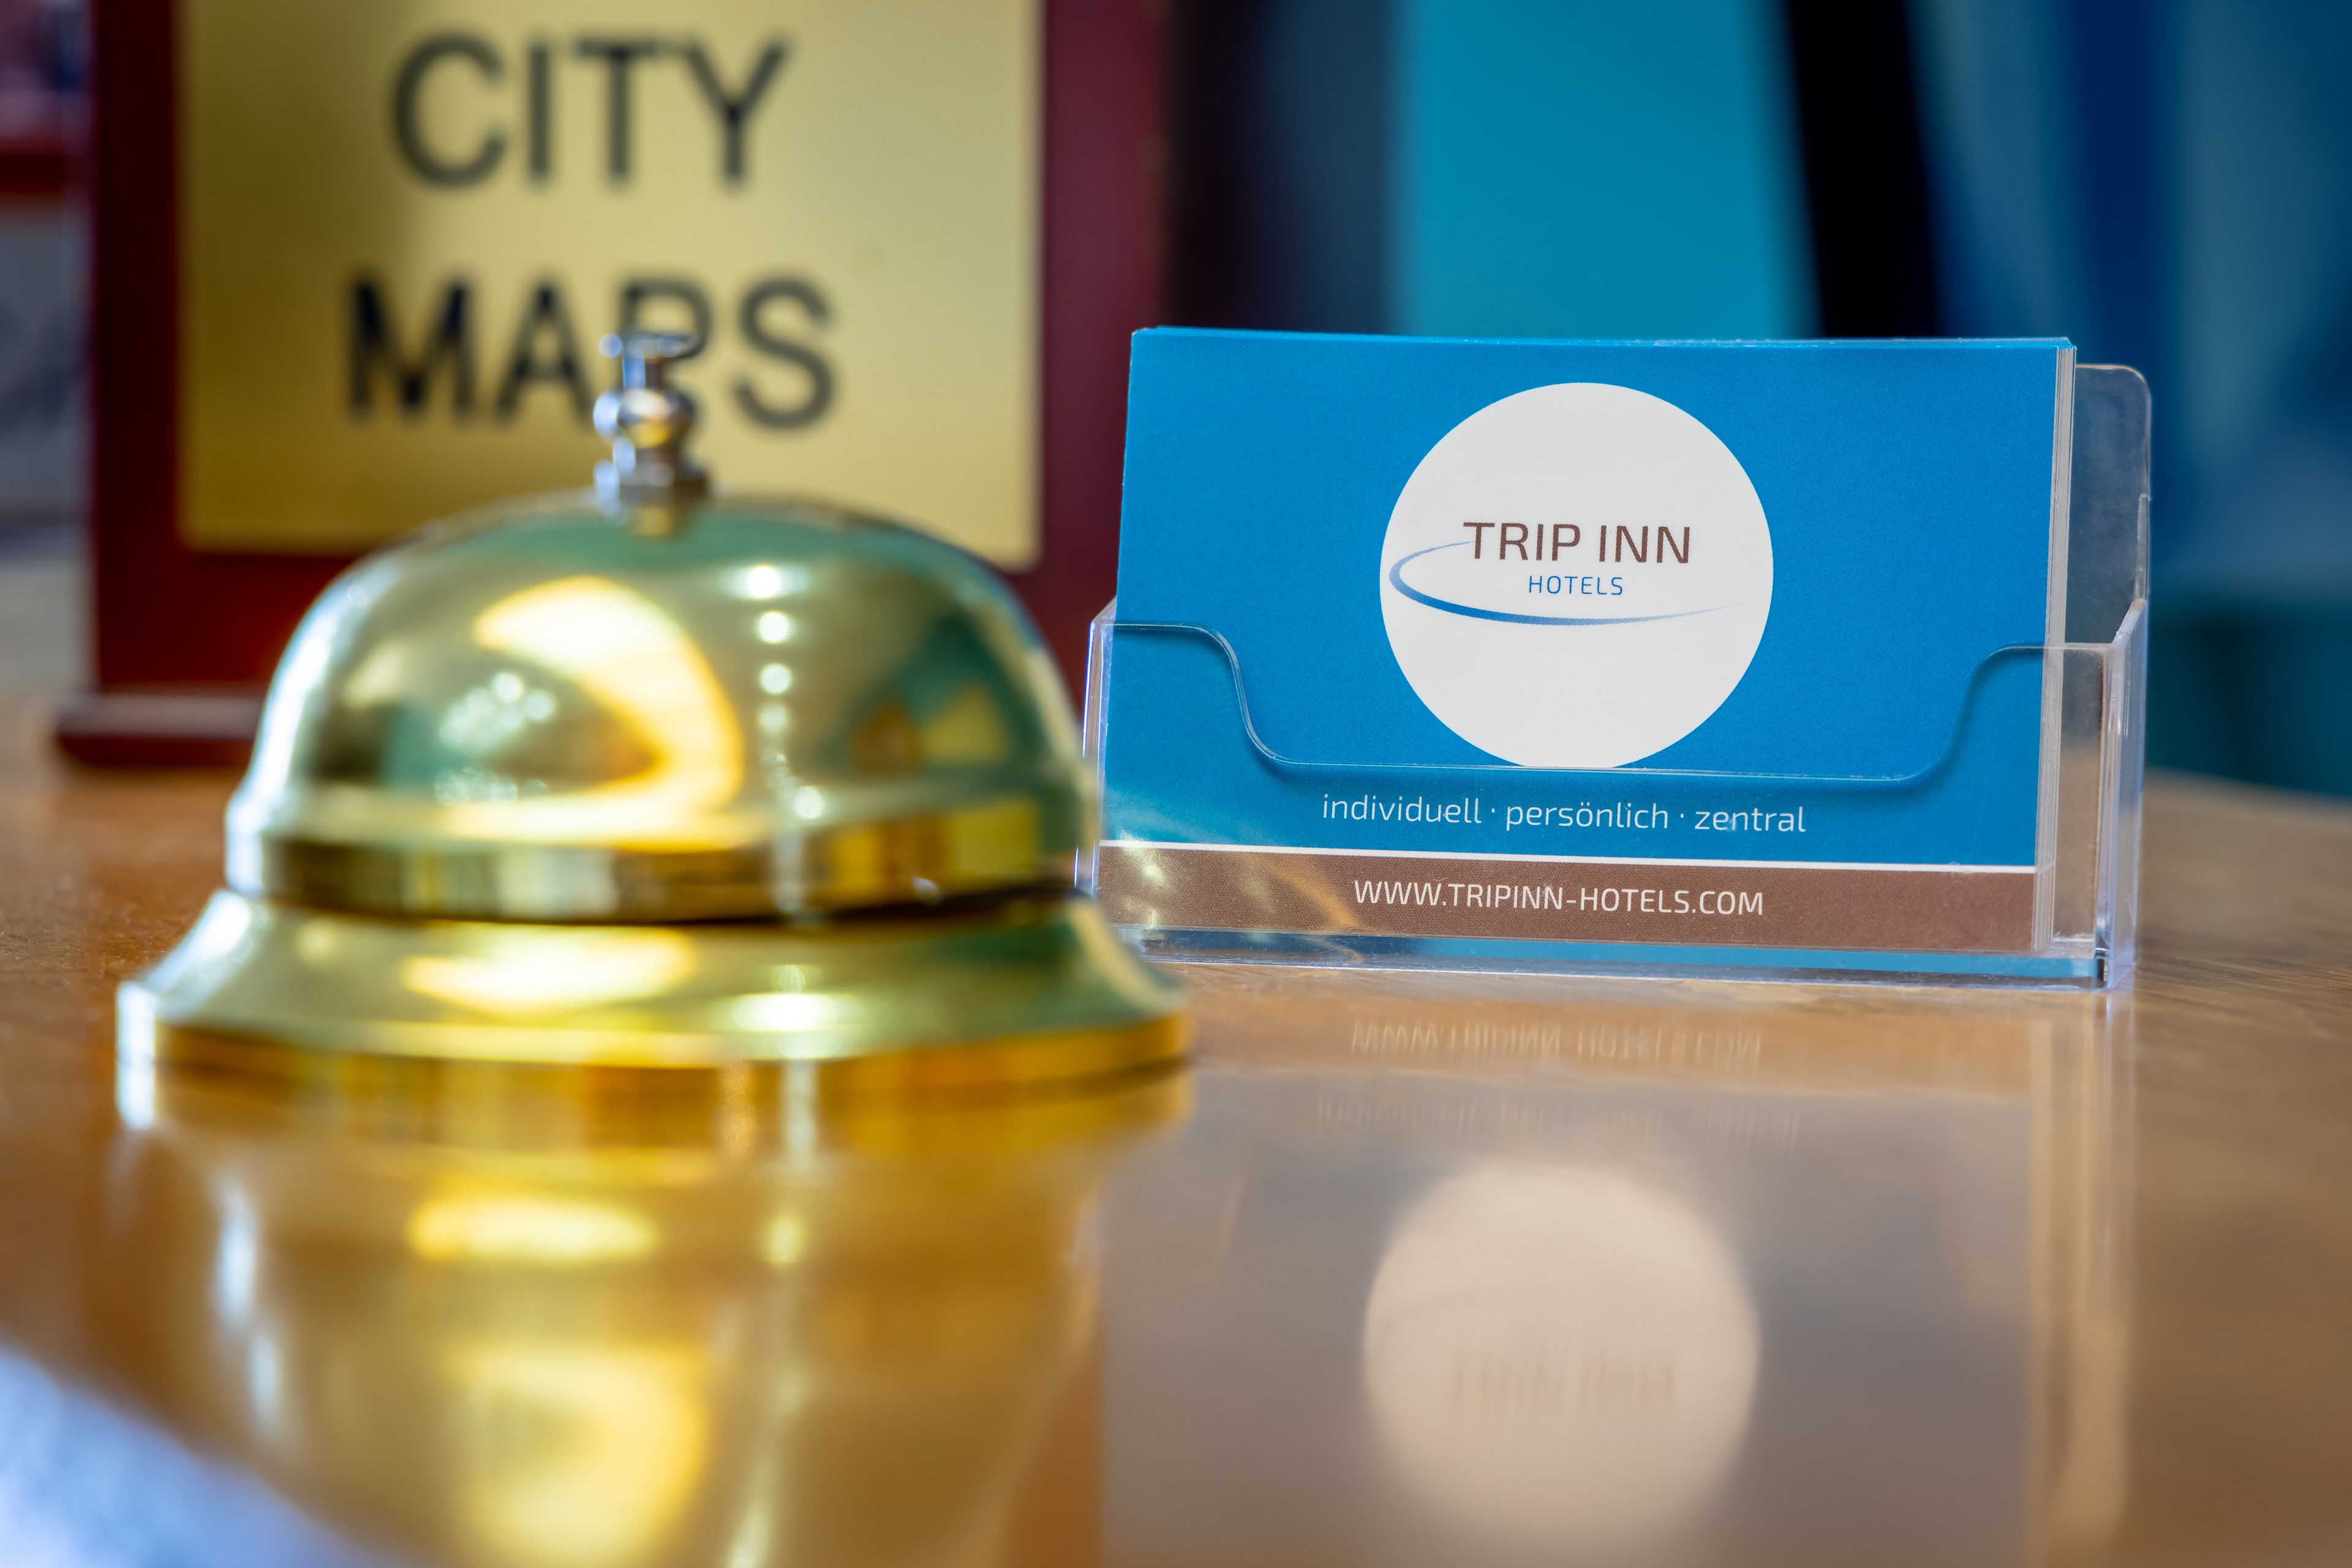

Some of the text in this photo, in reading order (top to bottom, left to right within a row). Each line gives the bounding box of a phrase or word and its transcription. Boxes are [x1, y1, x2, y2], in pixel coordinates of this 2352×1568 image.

[391, 29, 790, 191] CITY
[1463, 522, 1691, 564] TRIP INN
[1528, 575, 1623, 596] HOTELS
[1322, 793, 1806, 833] individuell persönlich zentral
[1353, 880, 1764, 916] WWW.TRIPINN-HOTELS.COM
